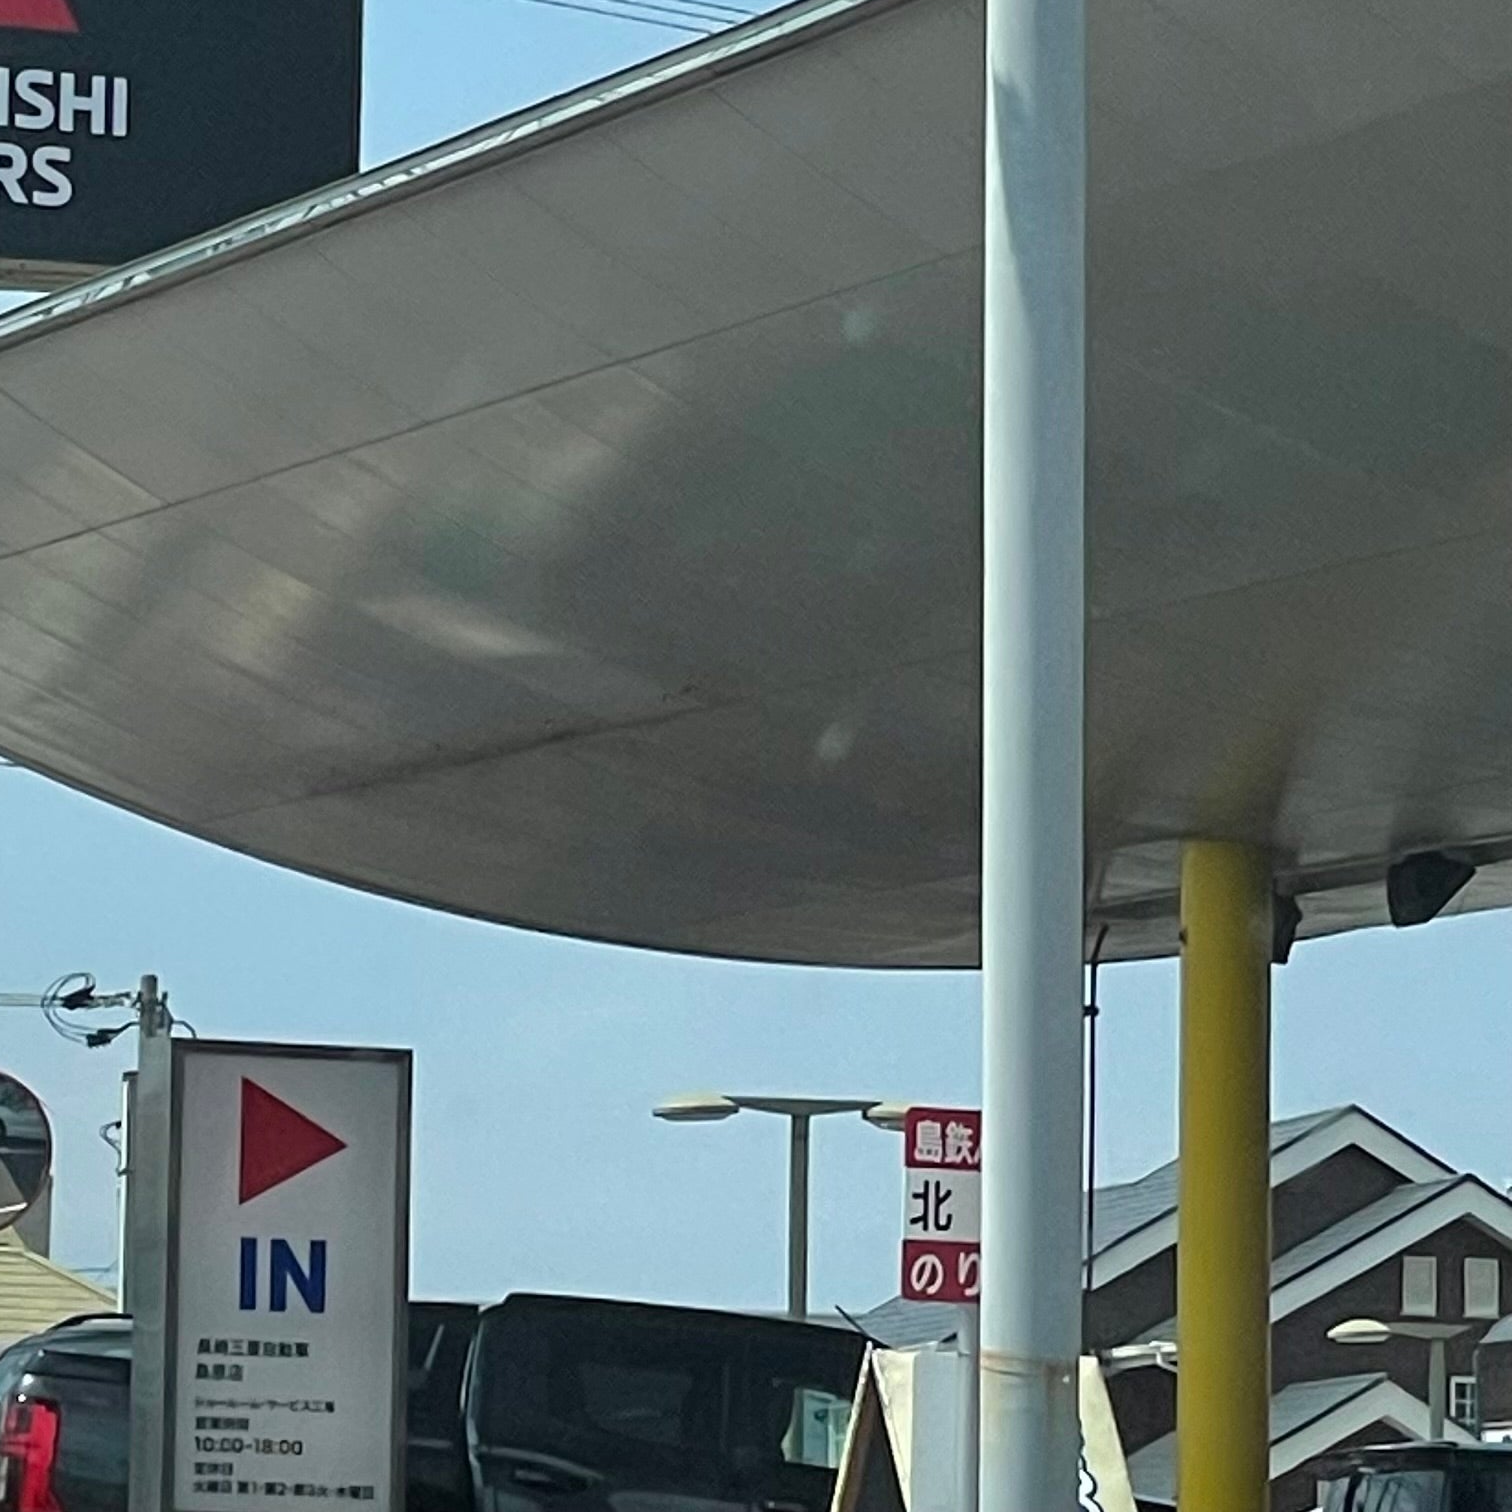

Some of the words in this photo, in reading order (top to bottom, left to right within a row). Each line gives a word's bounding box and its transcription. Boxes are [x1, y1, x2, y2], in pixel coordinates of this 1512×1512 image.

[914, 1119, 981, 1165] 島鉄
[910, 1180, 952, 1231] 北
[239, 1237, 326, 1314] IN
